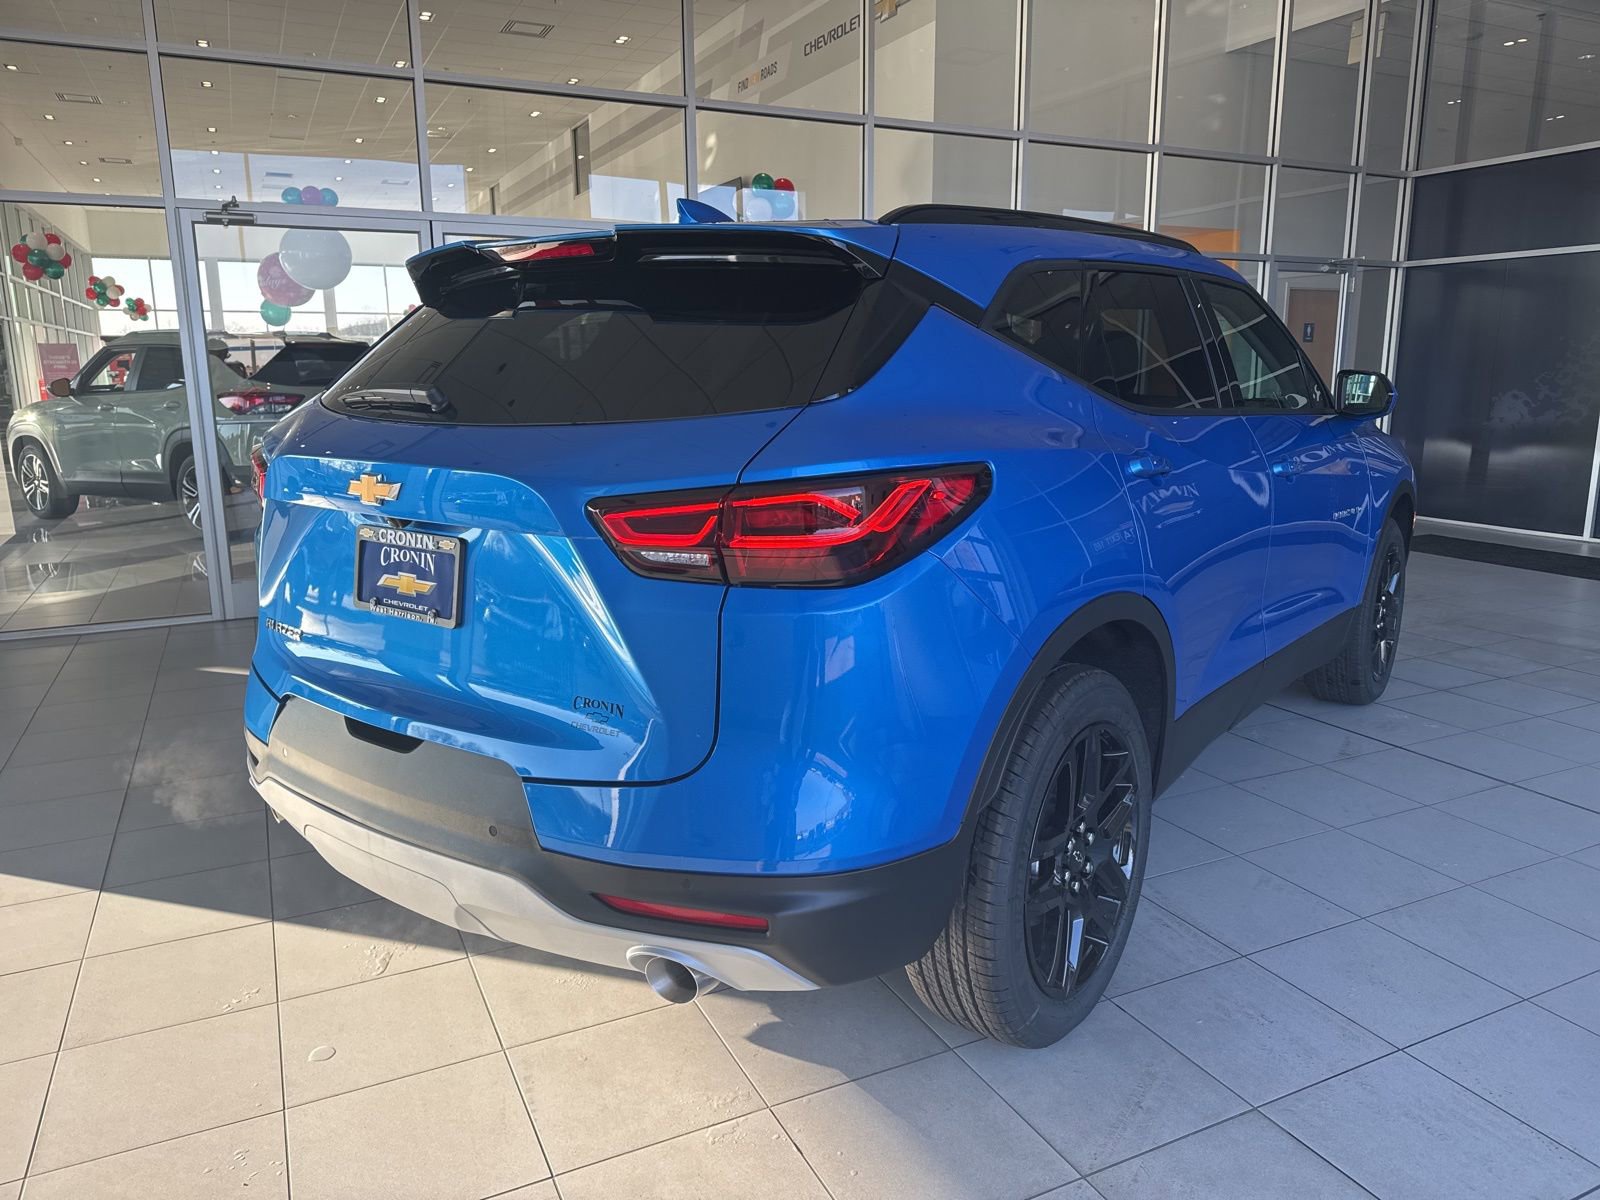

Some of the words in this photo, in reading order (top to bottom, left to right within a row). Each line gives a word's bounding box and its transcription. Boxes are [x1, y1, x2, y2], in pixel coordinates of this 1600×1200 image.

[737, 77, 749, 94] FIND
[760, 61, 778, 81] ROADS
[379, 529, 435, 551] CRONIN
[380, 546, 436, 576] CRONIN
[383, 598, 429, 612] CHEVROLET
[573, 695, 625, 720] CRONIN
[570, 720, 621, 737] CHEVROLET
